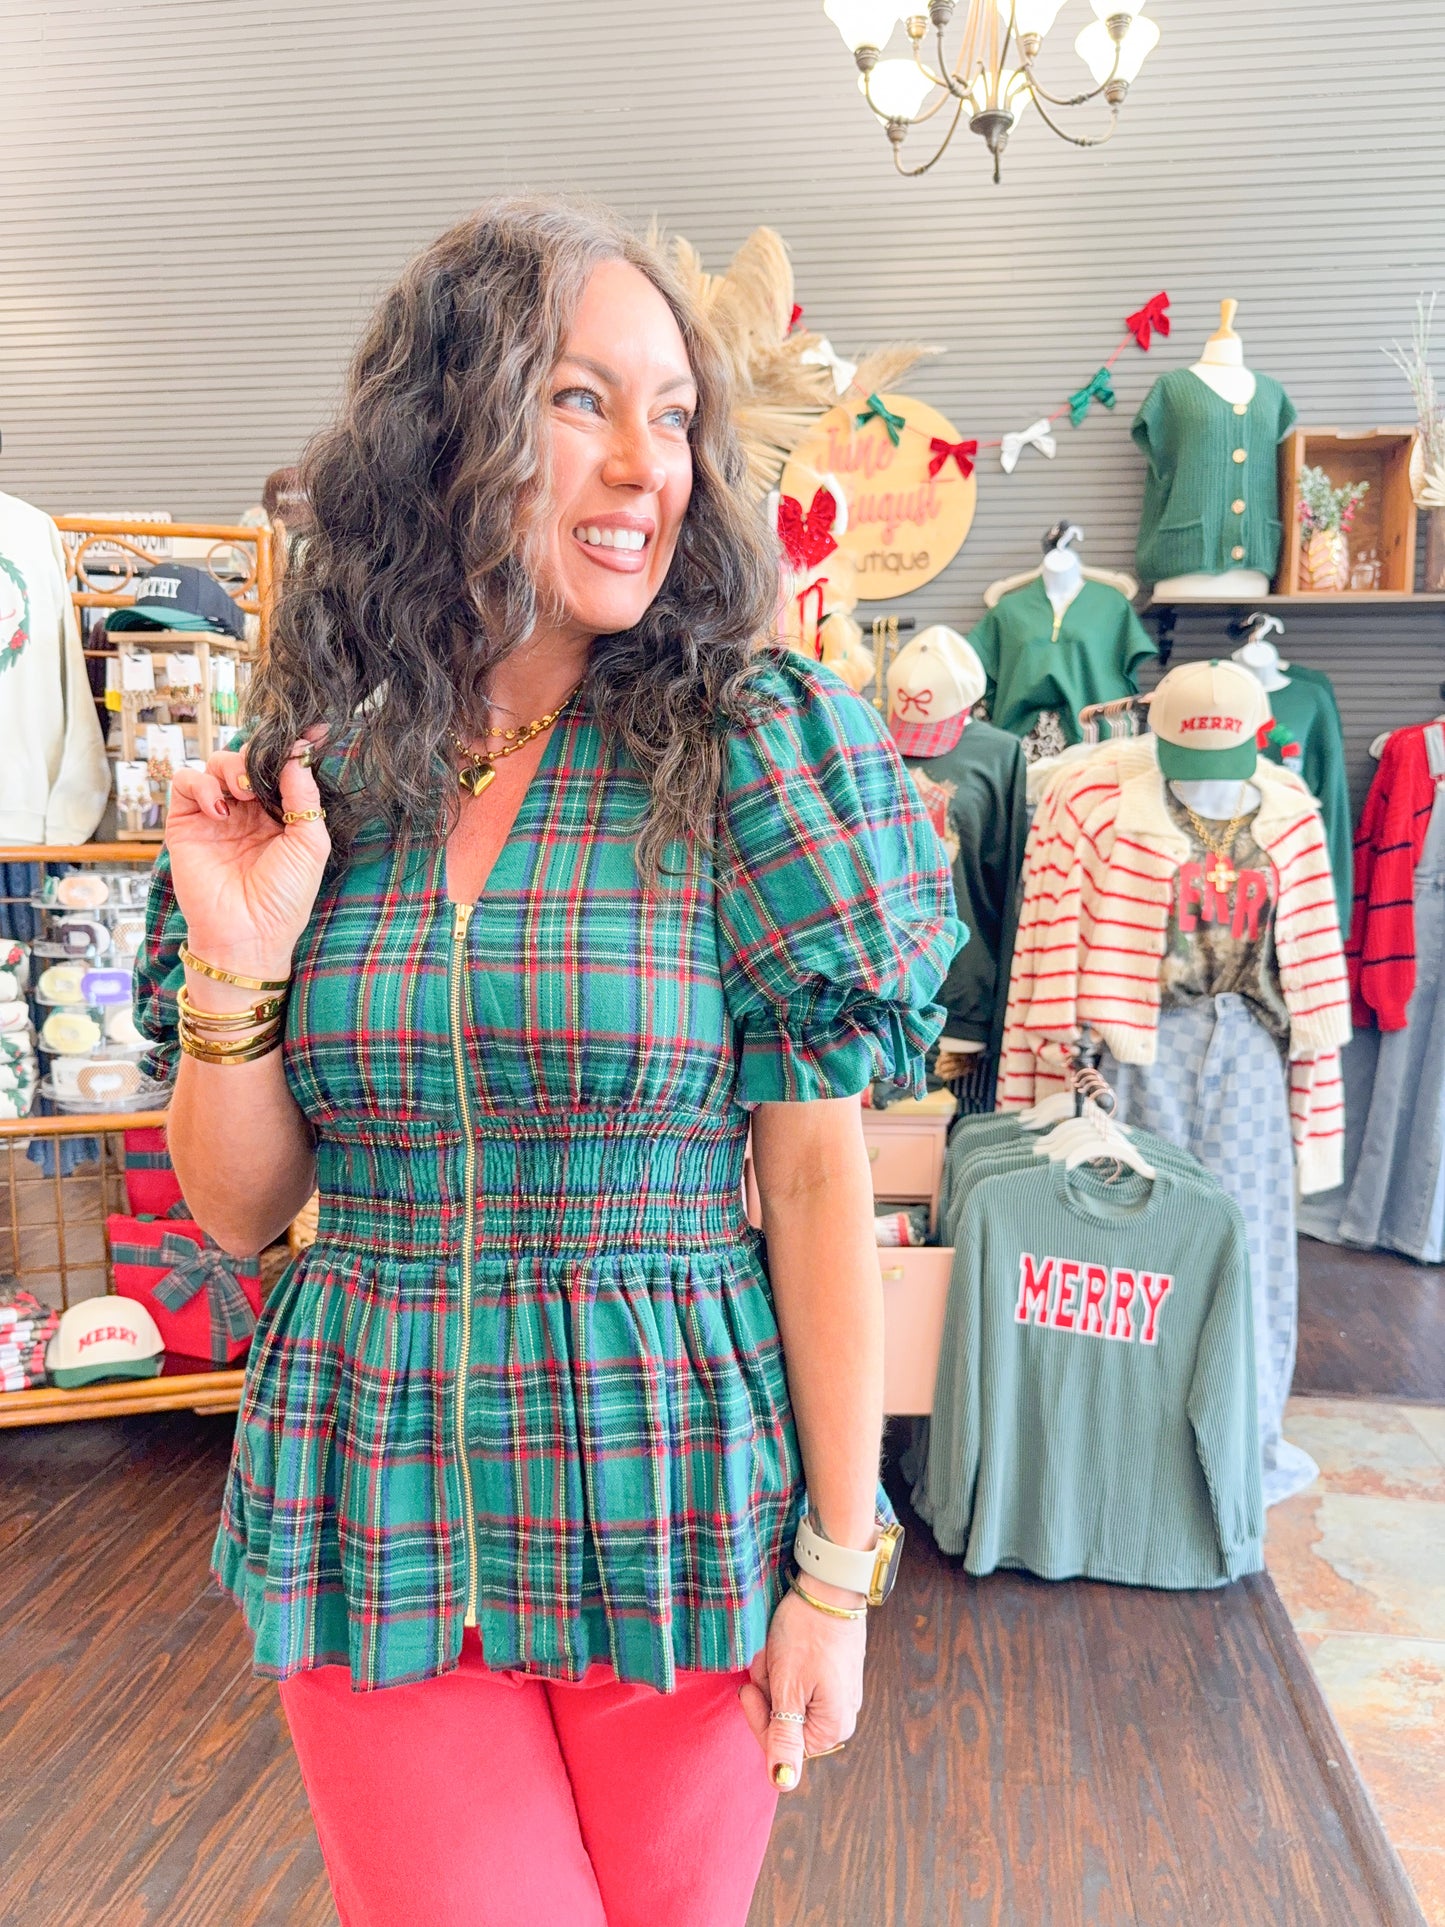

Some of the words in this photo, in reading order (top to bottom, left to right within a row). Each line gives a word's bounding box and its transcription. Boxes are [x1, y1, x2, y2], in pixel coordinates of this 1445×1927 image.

[848, 478, 955, 545] ugust
[1179, 716, 1242, 733] MERRY
[1014, 1252, 1174, 1346] MERRY
[78, 1326, 138, 1353] MERRY
